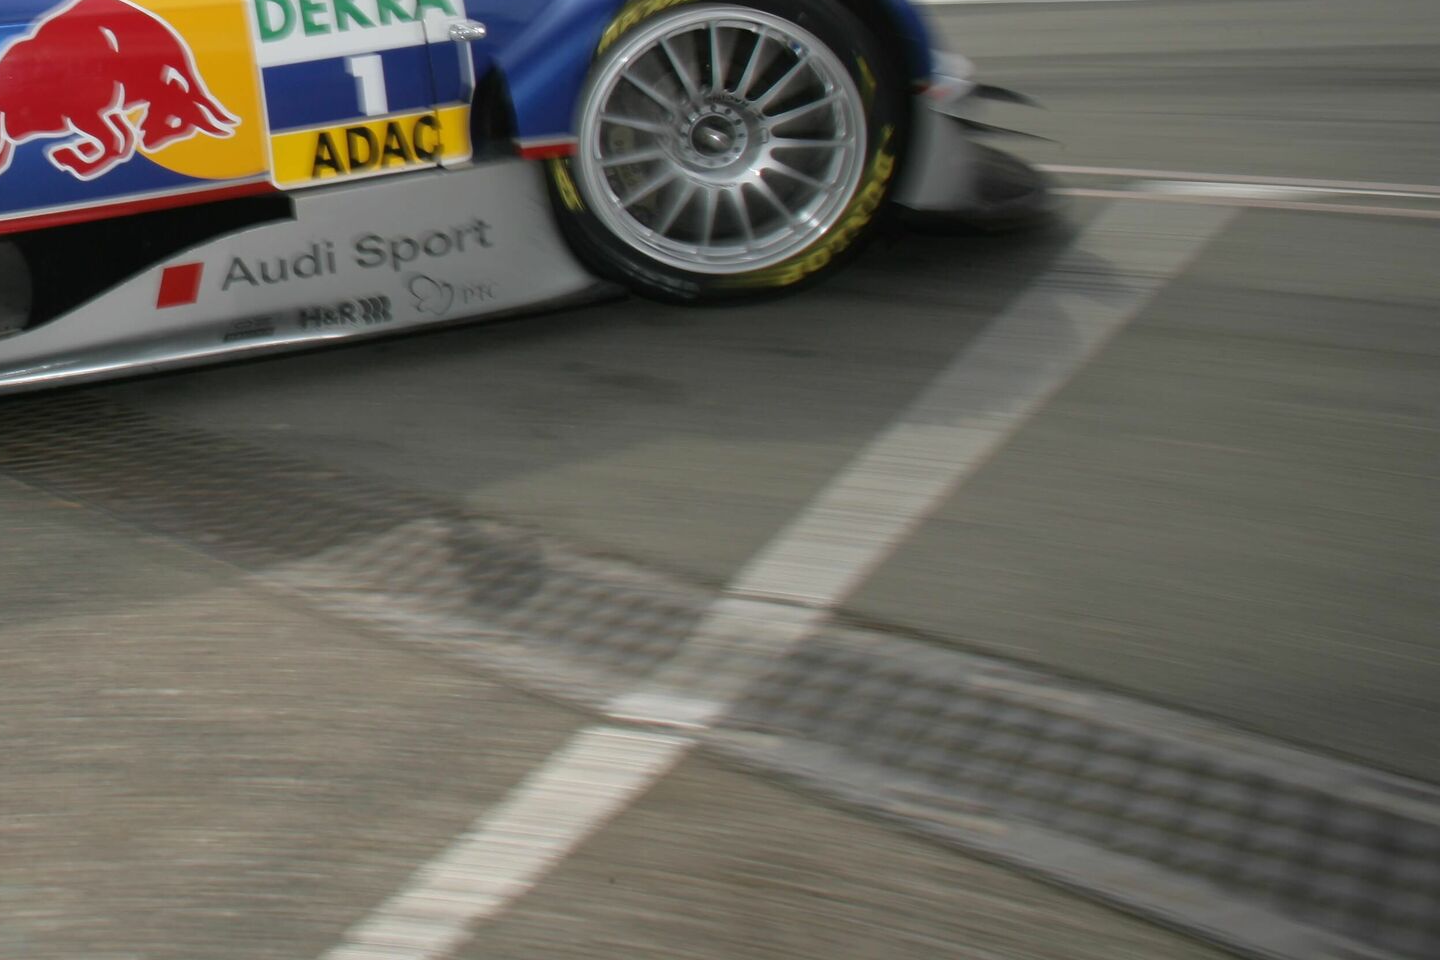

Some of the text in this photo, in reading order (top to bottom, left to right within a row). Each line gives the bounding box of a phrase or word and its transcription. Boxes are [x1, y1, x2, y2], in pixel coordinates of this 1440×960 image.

[345, 53, 389, 116] 1
[311, 114, 444, 180] ADAC
[221, 218, 493, 292] Audi Sport
